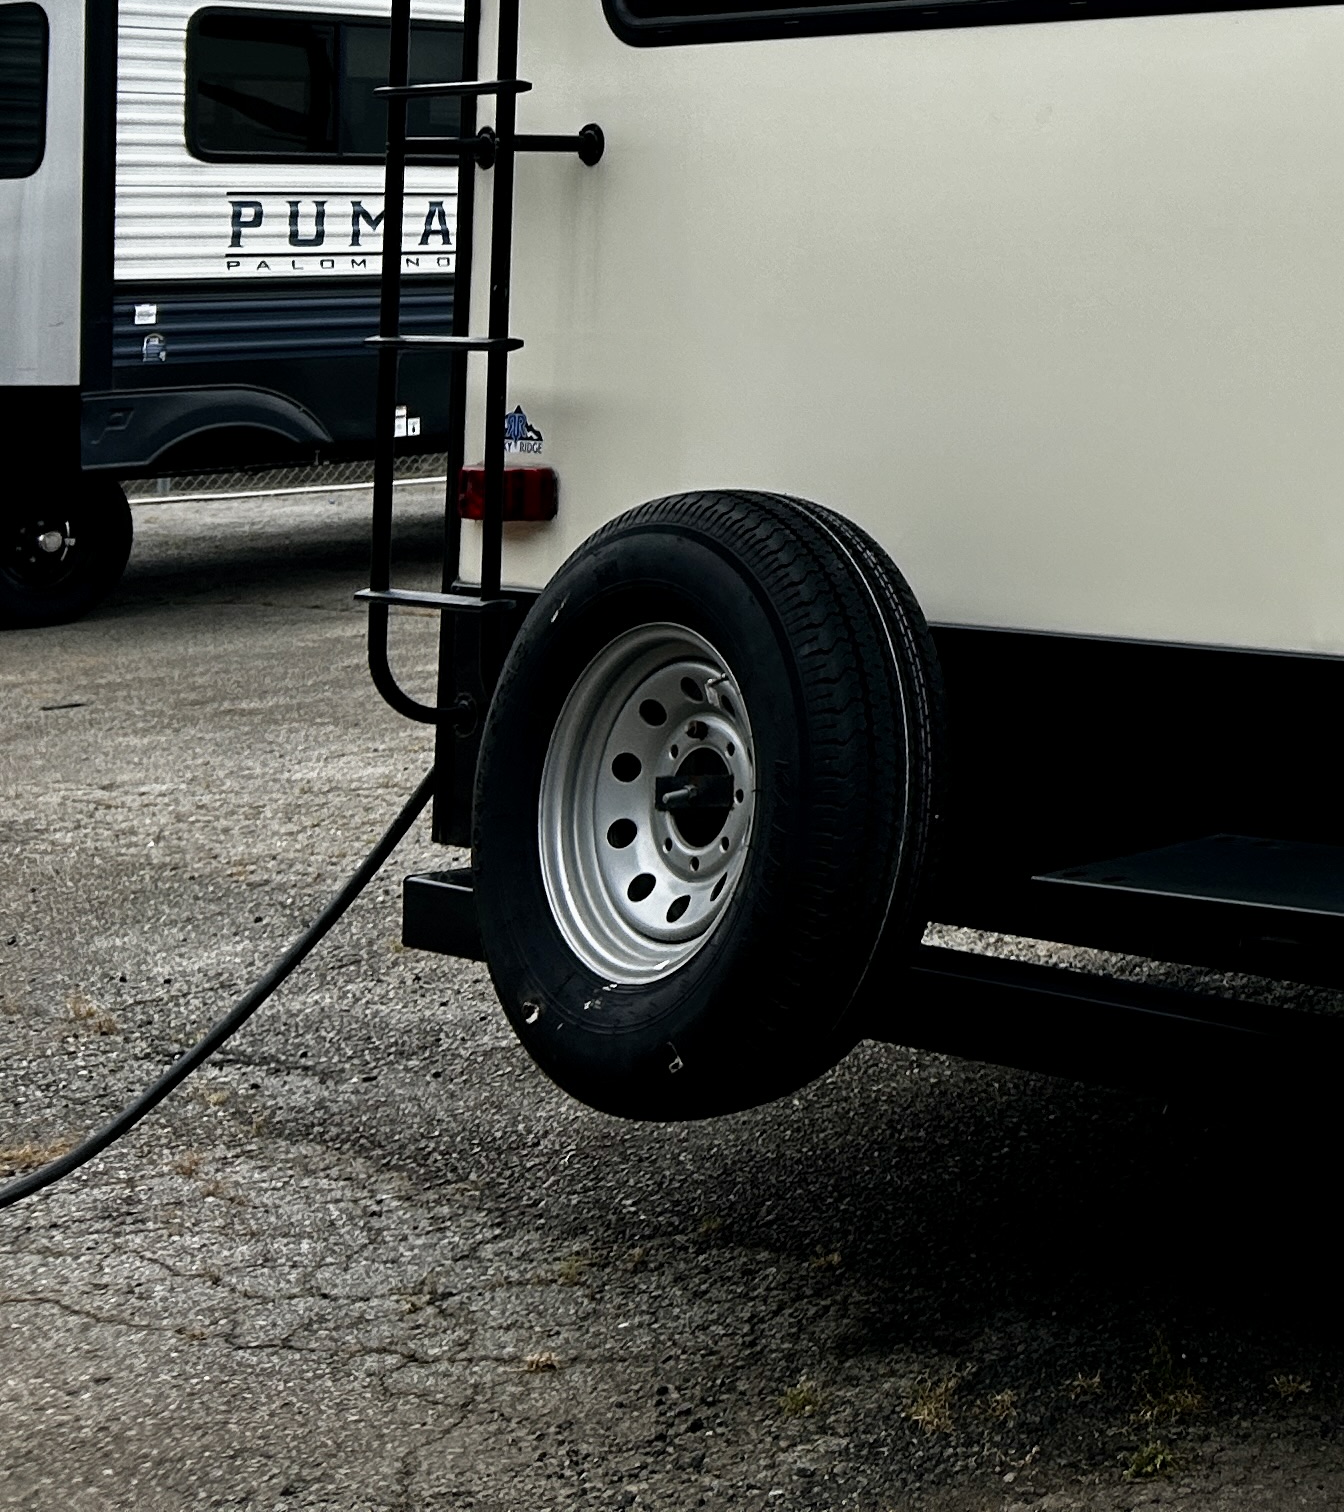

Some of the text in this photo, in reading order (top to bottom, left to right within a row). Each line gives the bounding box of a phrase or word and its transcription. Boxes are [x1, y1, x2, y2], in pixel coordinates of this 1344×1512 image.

[228, 200, 452, 248] PUMA
[226, 256, 450, 271] PALOMNO
[519, 441, 542, 454] RIDGE
